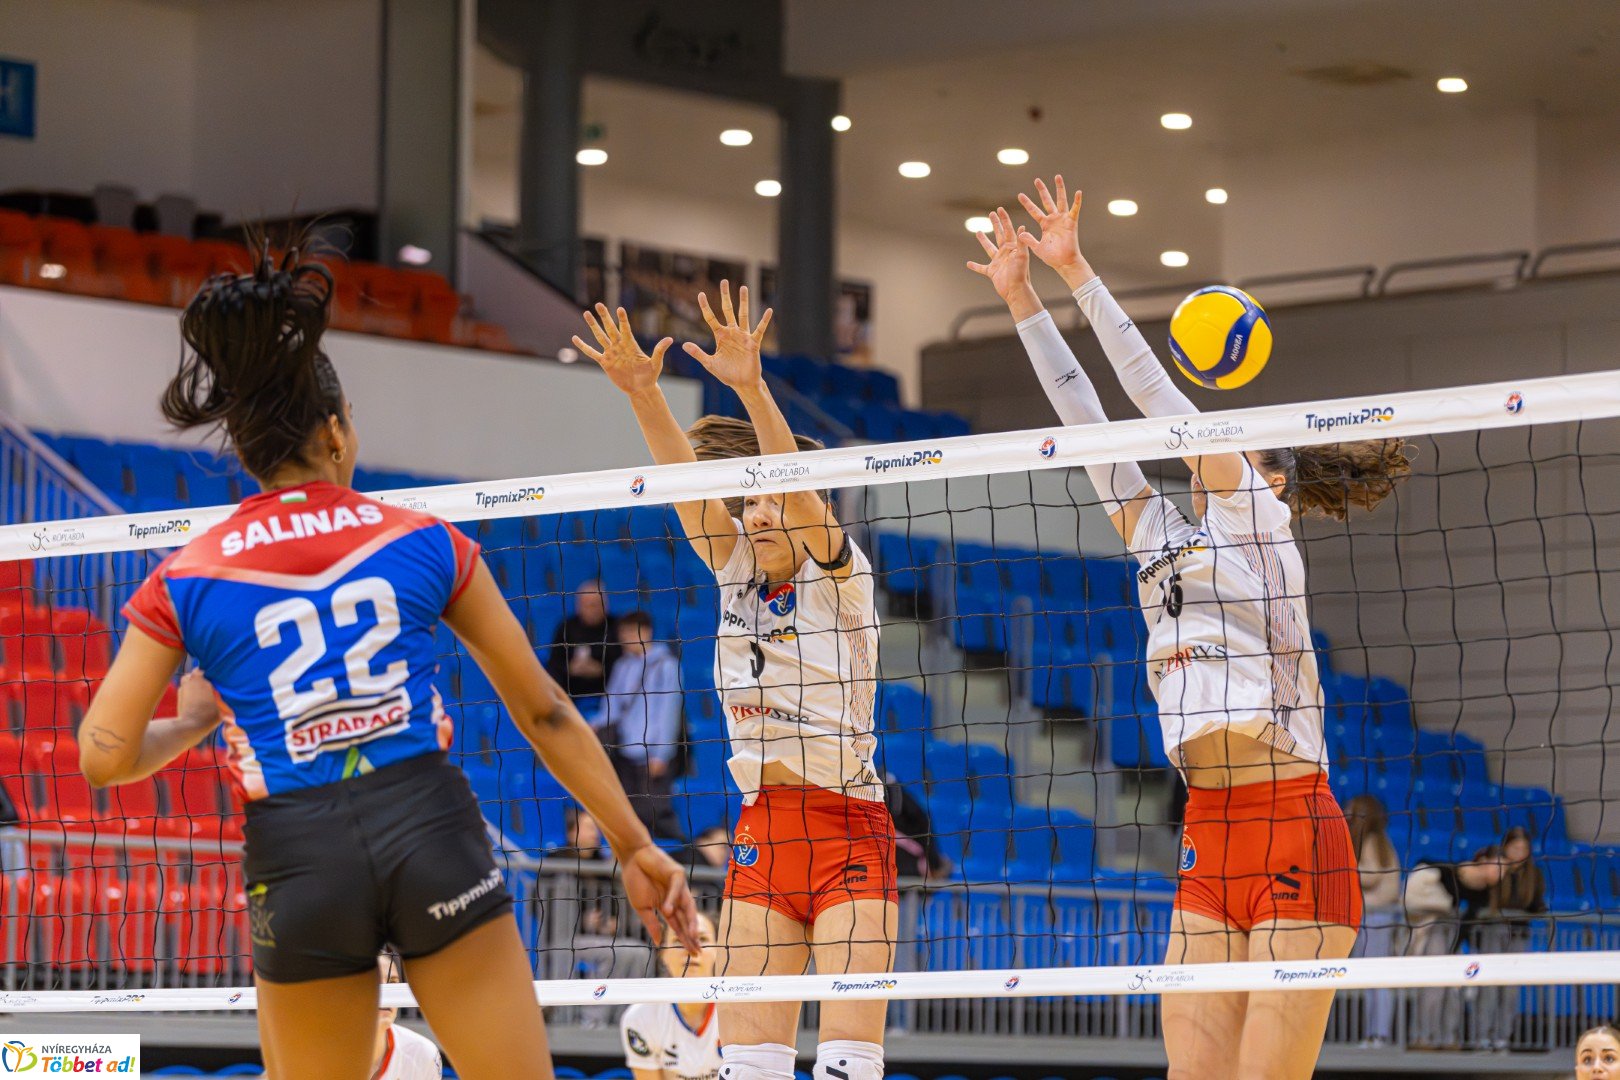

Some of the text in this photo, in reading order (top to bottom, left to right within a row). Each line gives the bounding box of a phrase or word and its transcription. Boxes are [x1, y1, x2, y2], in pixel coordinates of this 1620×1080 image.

[1229, 334, 1243, 362] V200W
[1305, 406, 1395, 432] TippmixPRO
[864, 449, 944, 473] TippmixPRO
[475, 486, 545, 508] TippmixPRO
[128, 519, 192, 539] TippmixPRO
[221, 504, 383, 557] SALINAS
[254, 576, 410, 720] 22
[831, 979, 898, 992] TippmixPRO
[1273, 967, 1348, 982] TippmixPRO
